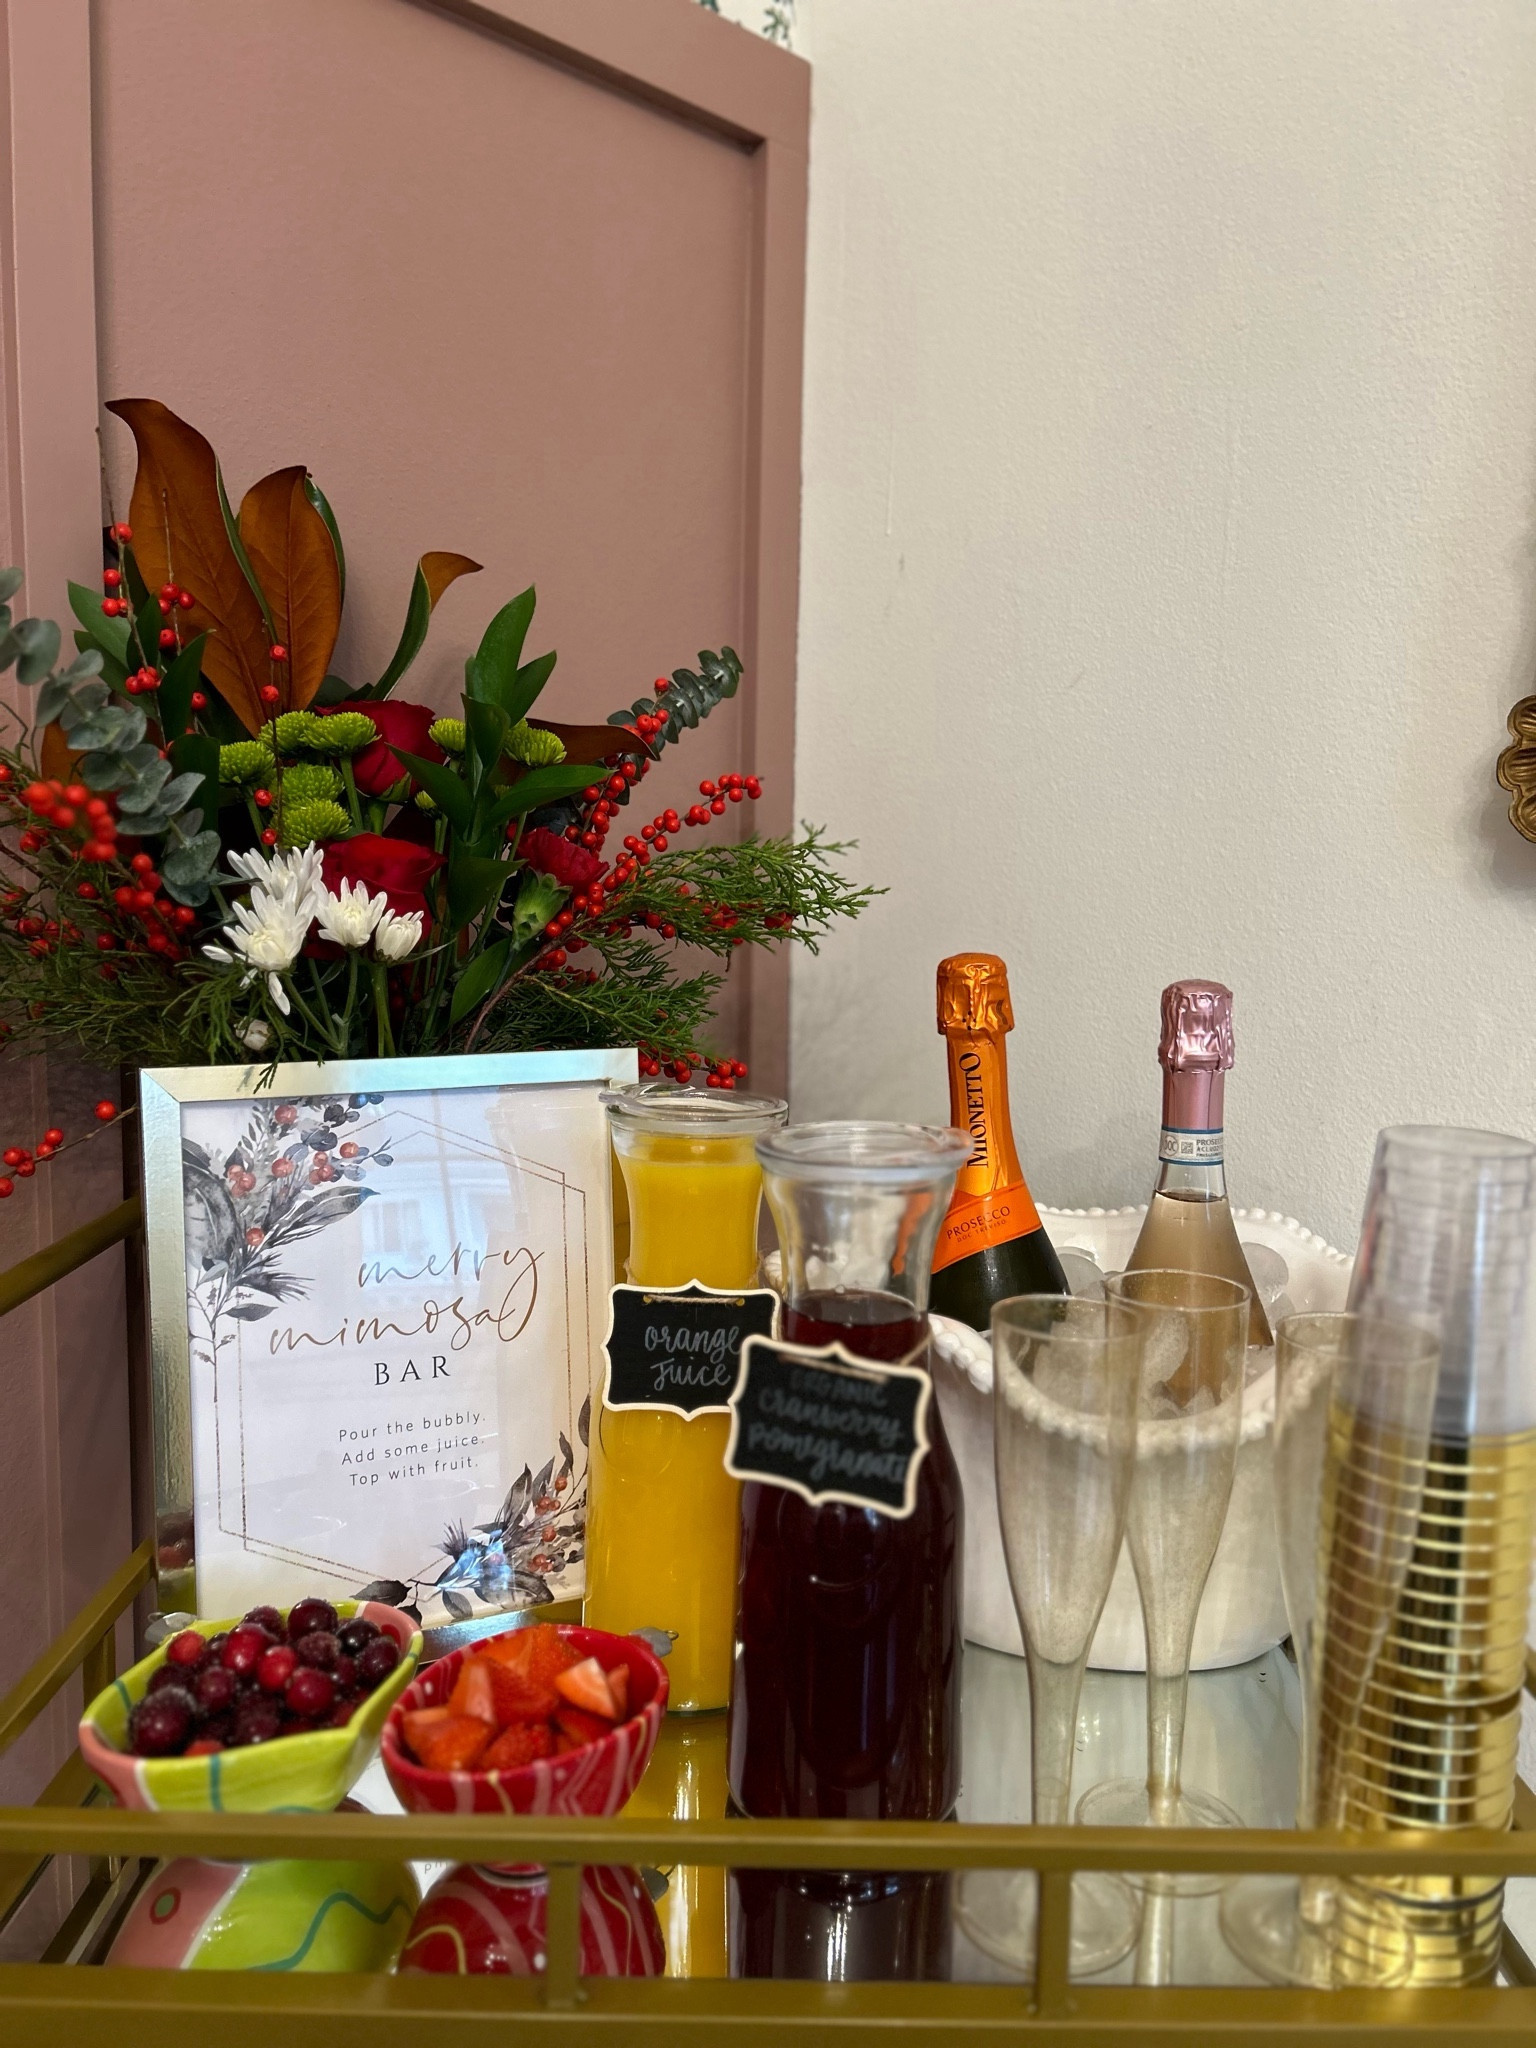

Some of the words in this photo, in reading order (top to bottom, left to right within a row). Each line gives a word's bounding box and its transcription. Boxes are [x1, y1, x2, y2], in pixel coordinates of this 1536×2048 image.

[959, 1052, 989, 1168] MIONETTO
[946, 1206, 1010, 1239] PROSECCO
[358, 1241, 545, 1342] merry
[269, 1297, 515, 1355] mimosa
[644, 1325, 741, 1364] orange
[374, 1355, 451, 1386] BAR
[339, 1427, 377, 1442] Pour
[387, 1421, 414, 1434] the
[423, 1411, 486, 1429] bubbly.
[341, 1448, 375, 1465] Add
[384, 1443, 429, 1458] some
[437, 1435, 484, 1452] juice.
[350, 1473, 379, 1486] Top
[389, 1464, 425, 1480] with
[435, 1456, 478, 1473] fruit.
